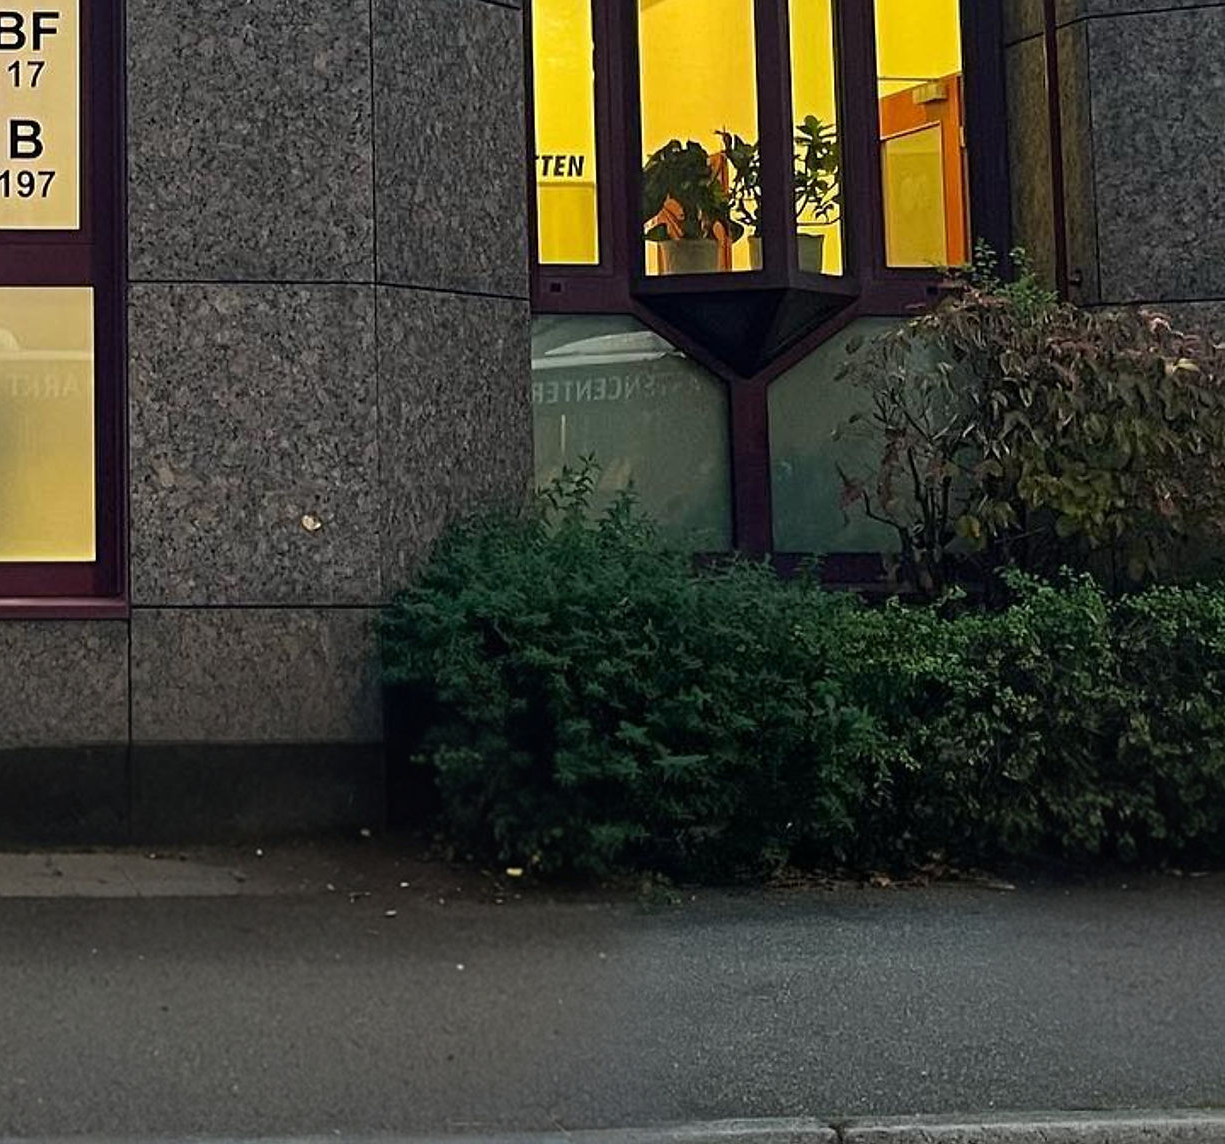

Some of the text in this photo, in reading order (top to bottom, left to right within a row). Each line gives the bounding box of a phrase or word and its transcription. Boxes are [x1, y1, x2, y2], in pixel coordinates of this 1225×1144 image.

[9, 61, 44, 87] 17
[11, 120, 43, 158] B
[0, 170, 55, 197] 197
